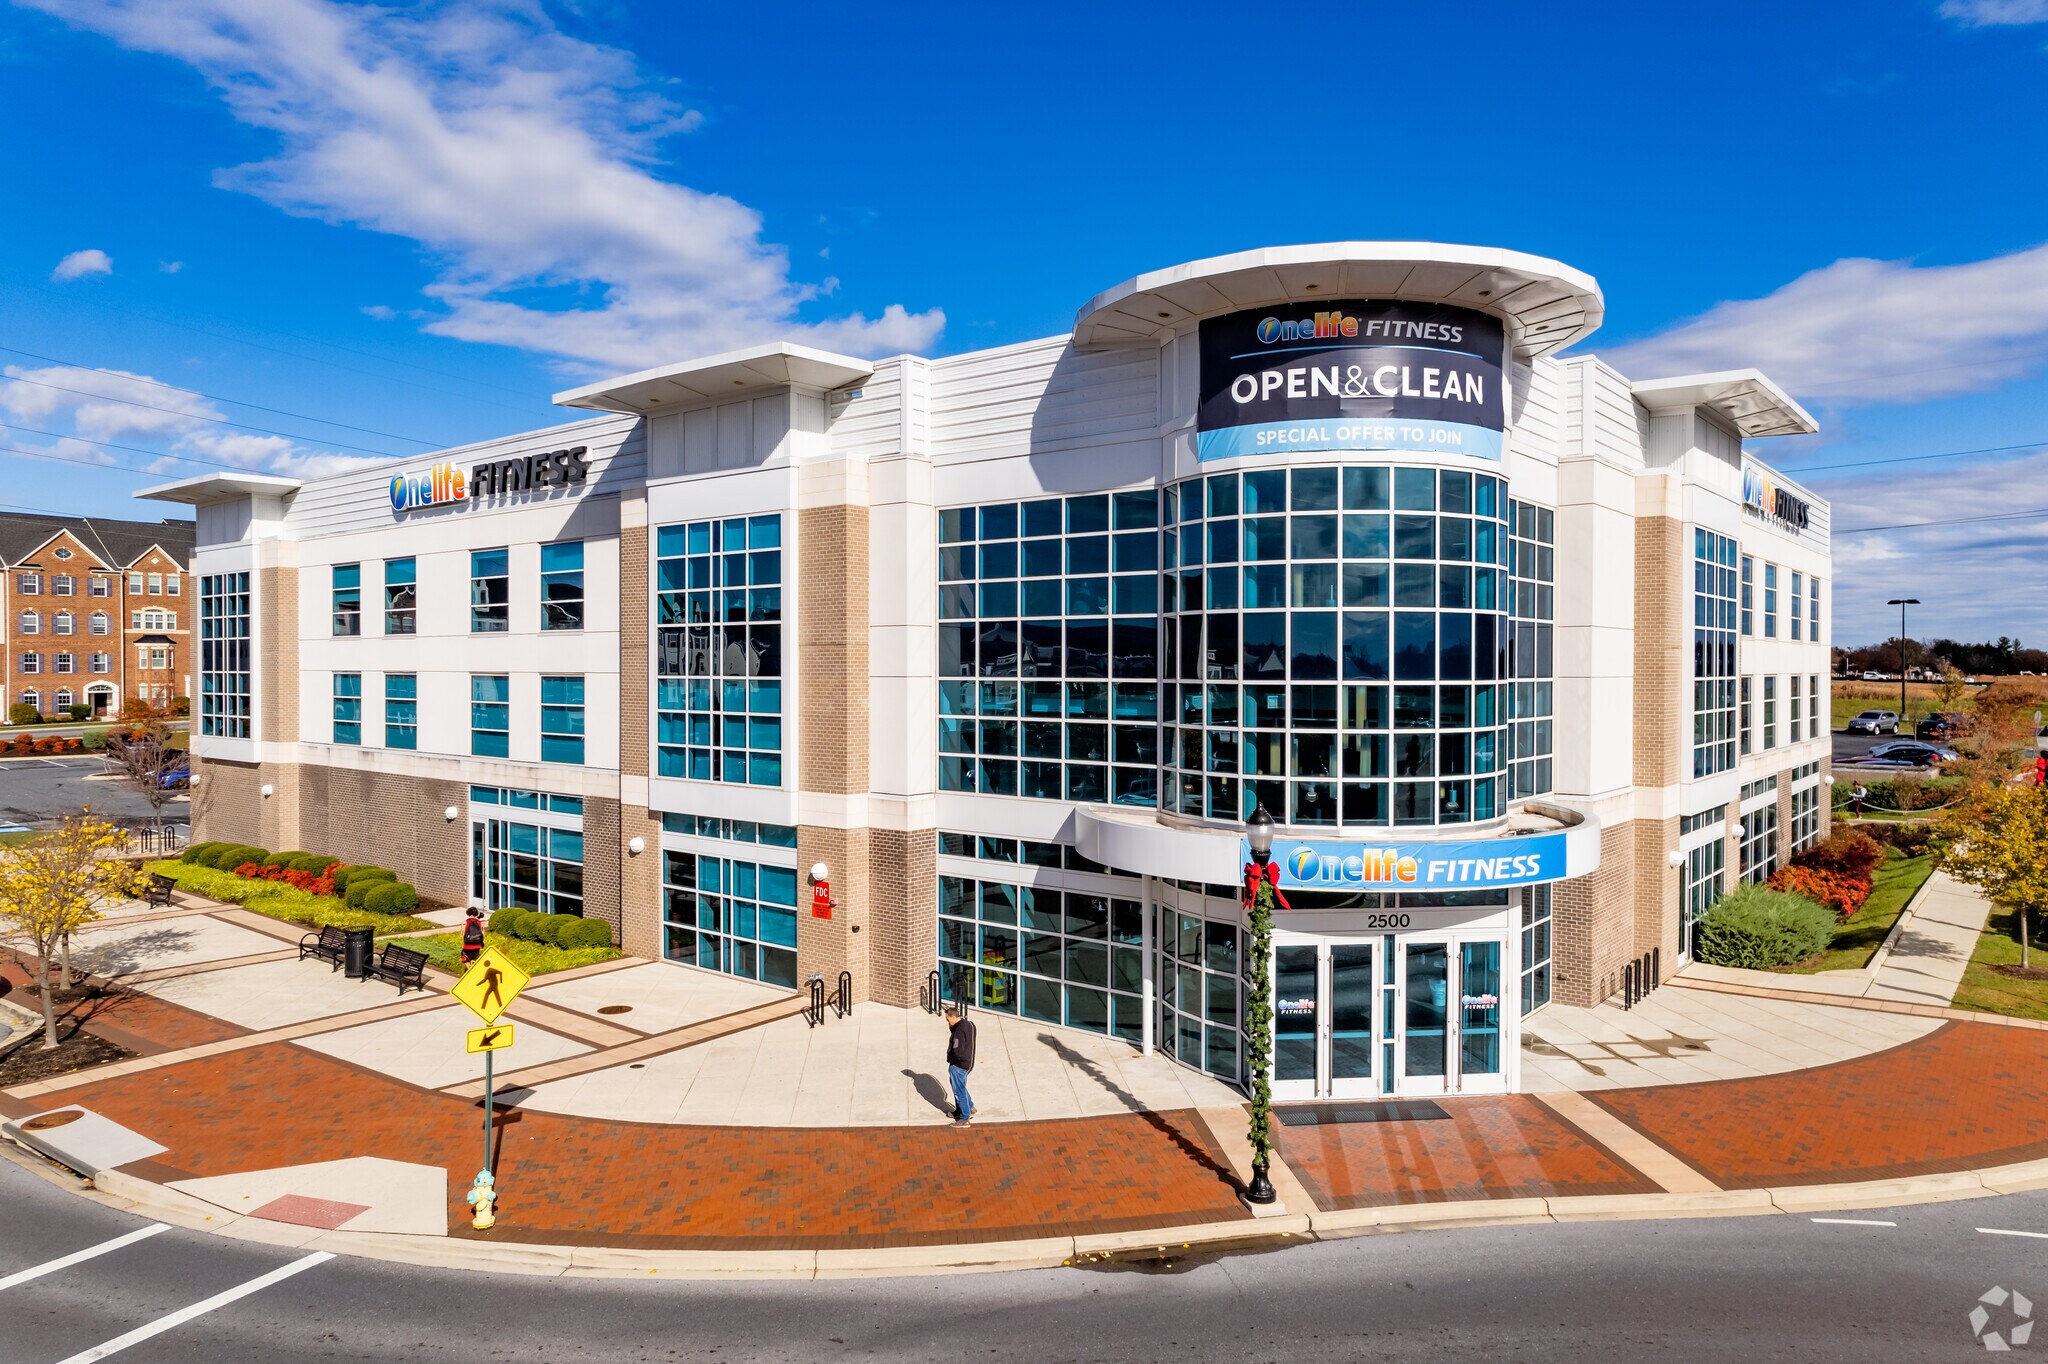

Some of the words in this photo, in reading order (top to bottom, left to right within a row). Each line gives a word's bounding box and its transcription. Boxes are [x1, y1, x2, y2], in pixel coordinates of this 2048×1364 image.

[1257, 311, 1359, 344] Onelife
[1366, 320, 1462, 343] FITNESS
[1256, 427, 1330, 446] SPECIAL
[1336, 426, 1395, 442] OFFER
[1400, 427, 1424, 442] TO
[1428, 429, 1462, 445] JOIN
[389, 462, 466, 511] Onelife
[471, 446, 588, 497] FITNESS
[1287, 847, 1418, 883] Onelife
[1427, 854, 1541, 883] FITNESS
[816, 887, 827, 897] FDC
[1367, 914, 1410, 928] 2500
